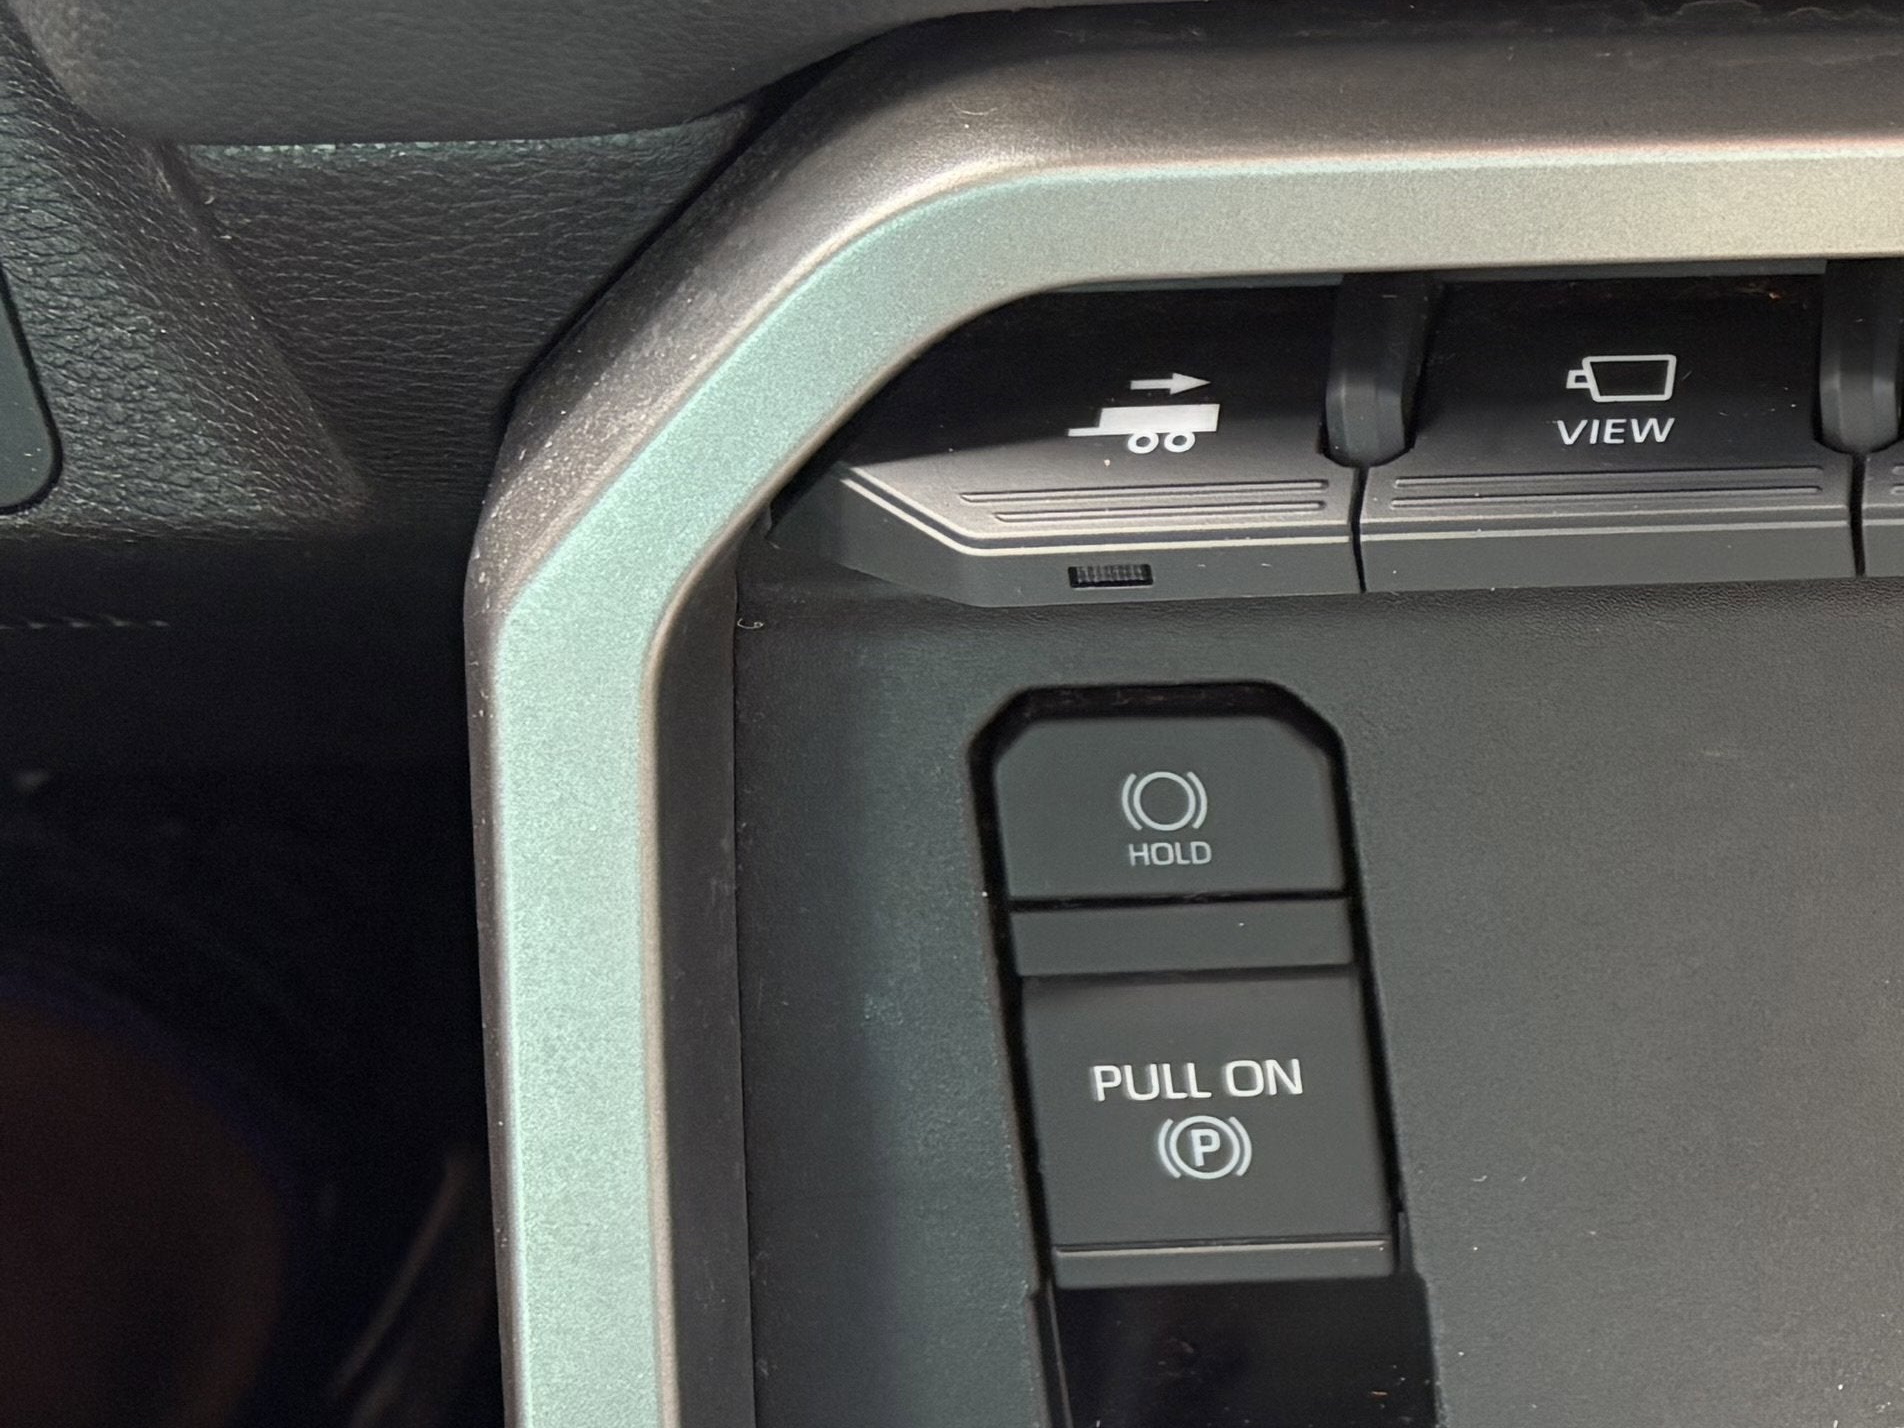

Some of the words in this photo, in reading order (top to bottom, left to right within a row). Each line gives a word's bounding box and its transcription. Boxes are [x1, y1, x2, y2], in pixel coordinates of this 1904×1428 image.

[1556, 416, 1676, 446] VIEW
[1128, 841, 1212, 867] HOLD
[1092, 1062, 1213, 1102] PULL
[1223, 1058, 1304, 1098] ON
[1189, 1127, 1221, 1167] P
